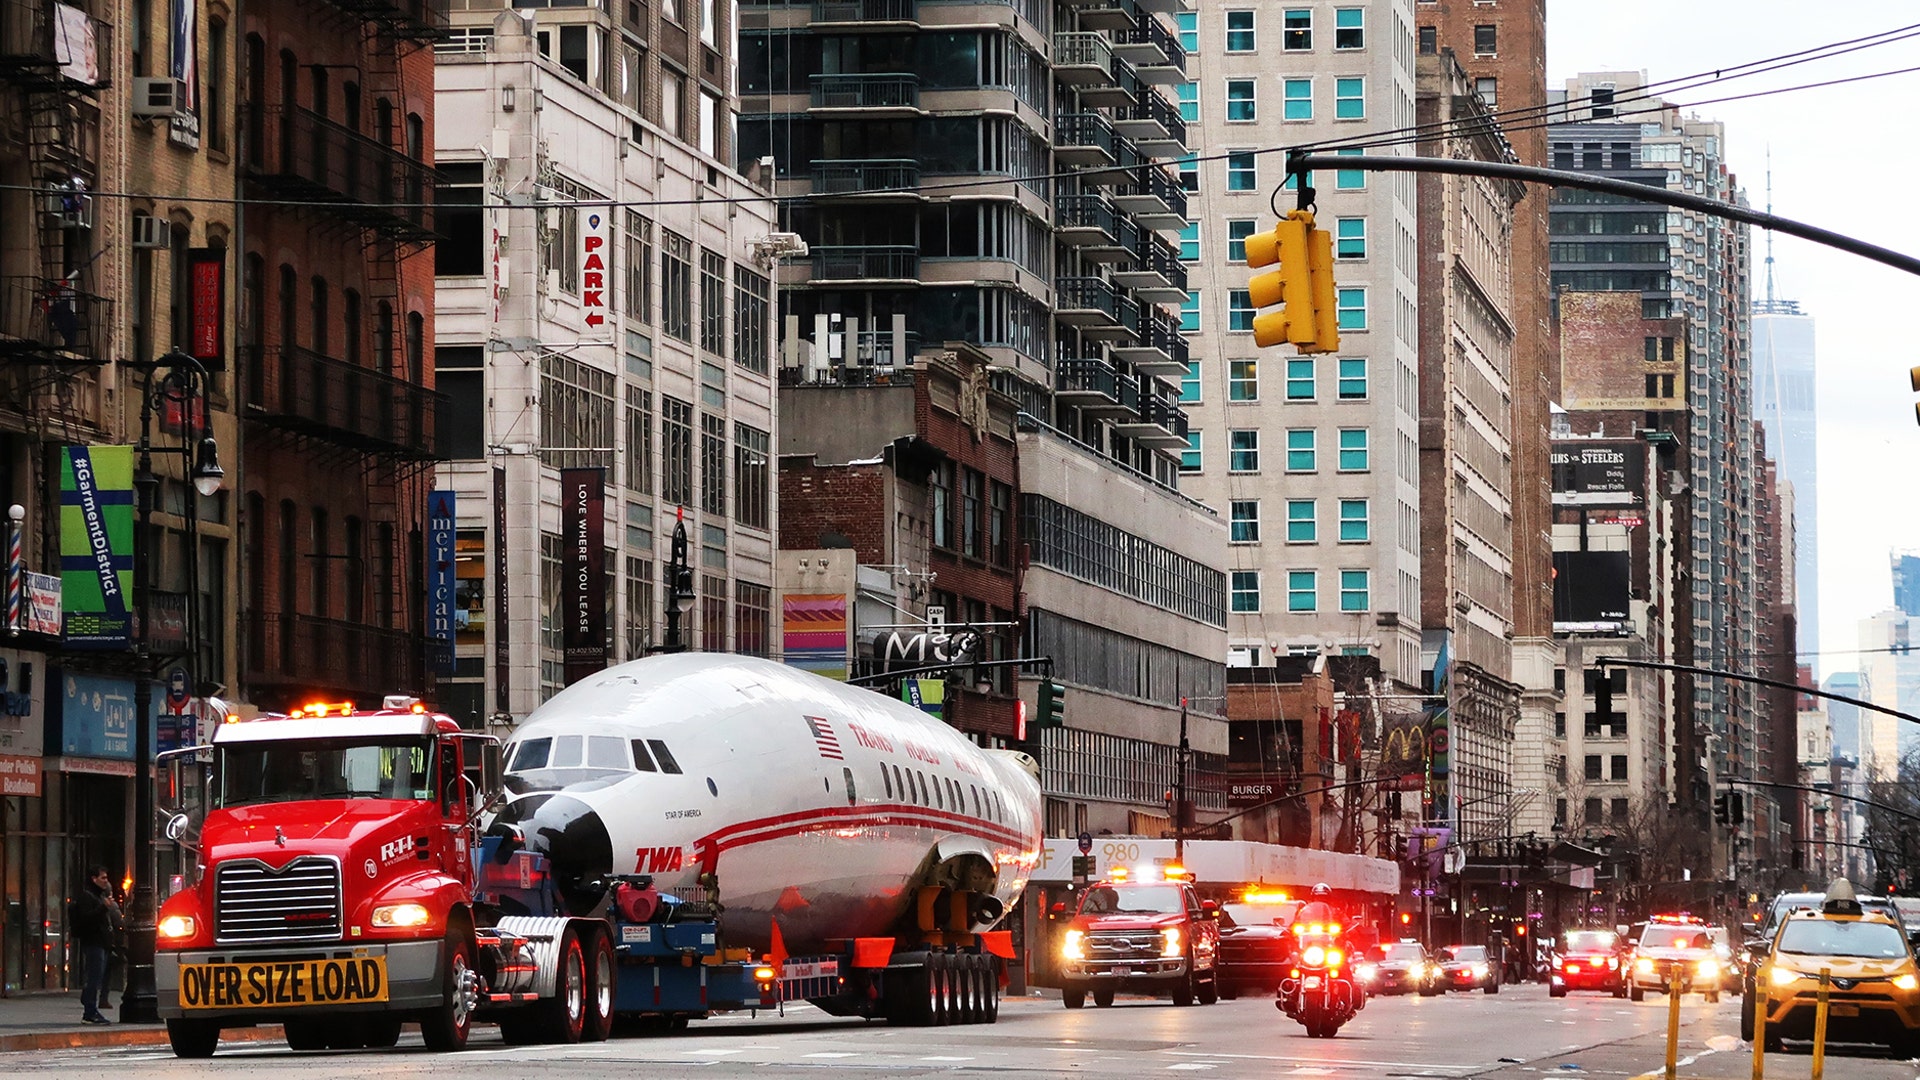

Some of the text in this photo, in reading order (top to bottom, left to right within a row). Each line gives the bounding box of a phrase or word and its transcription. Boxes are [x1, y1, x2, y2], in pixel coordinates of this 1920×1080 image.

[583, 236, 605, 307] PARK
[1581, 453, 1624, 464] STEELERS
[1606, 470, 1624, 478] Diddy
[75, 458, 118, 596] #GarmentDistrict
[578, 484, 589, 633] LOVE WHERE YOU LEASE
[848, 723, 894, 753] TRANS
[1232, 785, 1272, 794] BURGER
[665, 809, 702, 819] STAR OF AMERICA
[634, 847, 682, 874] TWA
[1103, 843, 1140, 861] 980
[284, 913, 331, 921] MACK
[184, 959, 381, 1006] OVER SIZE LOAD
